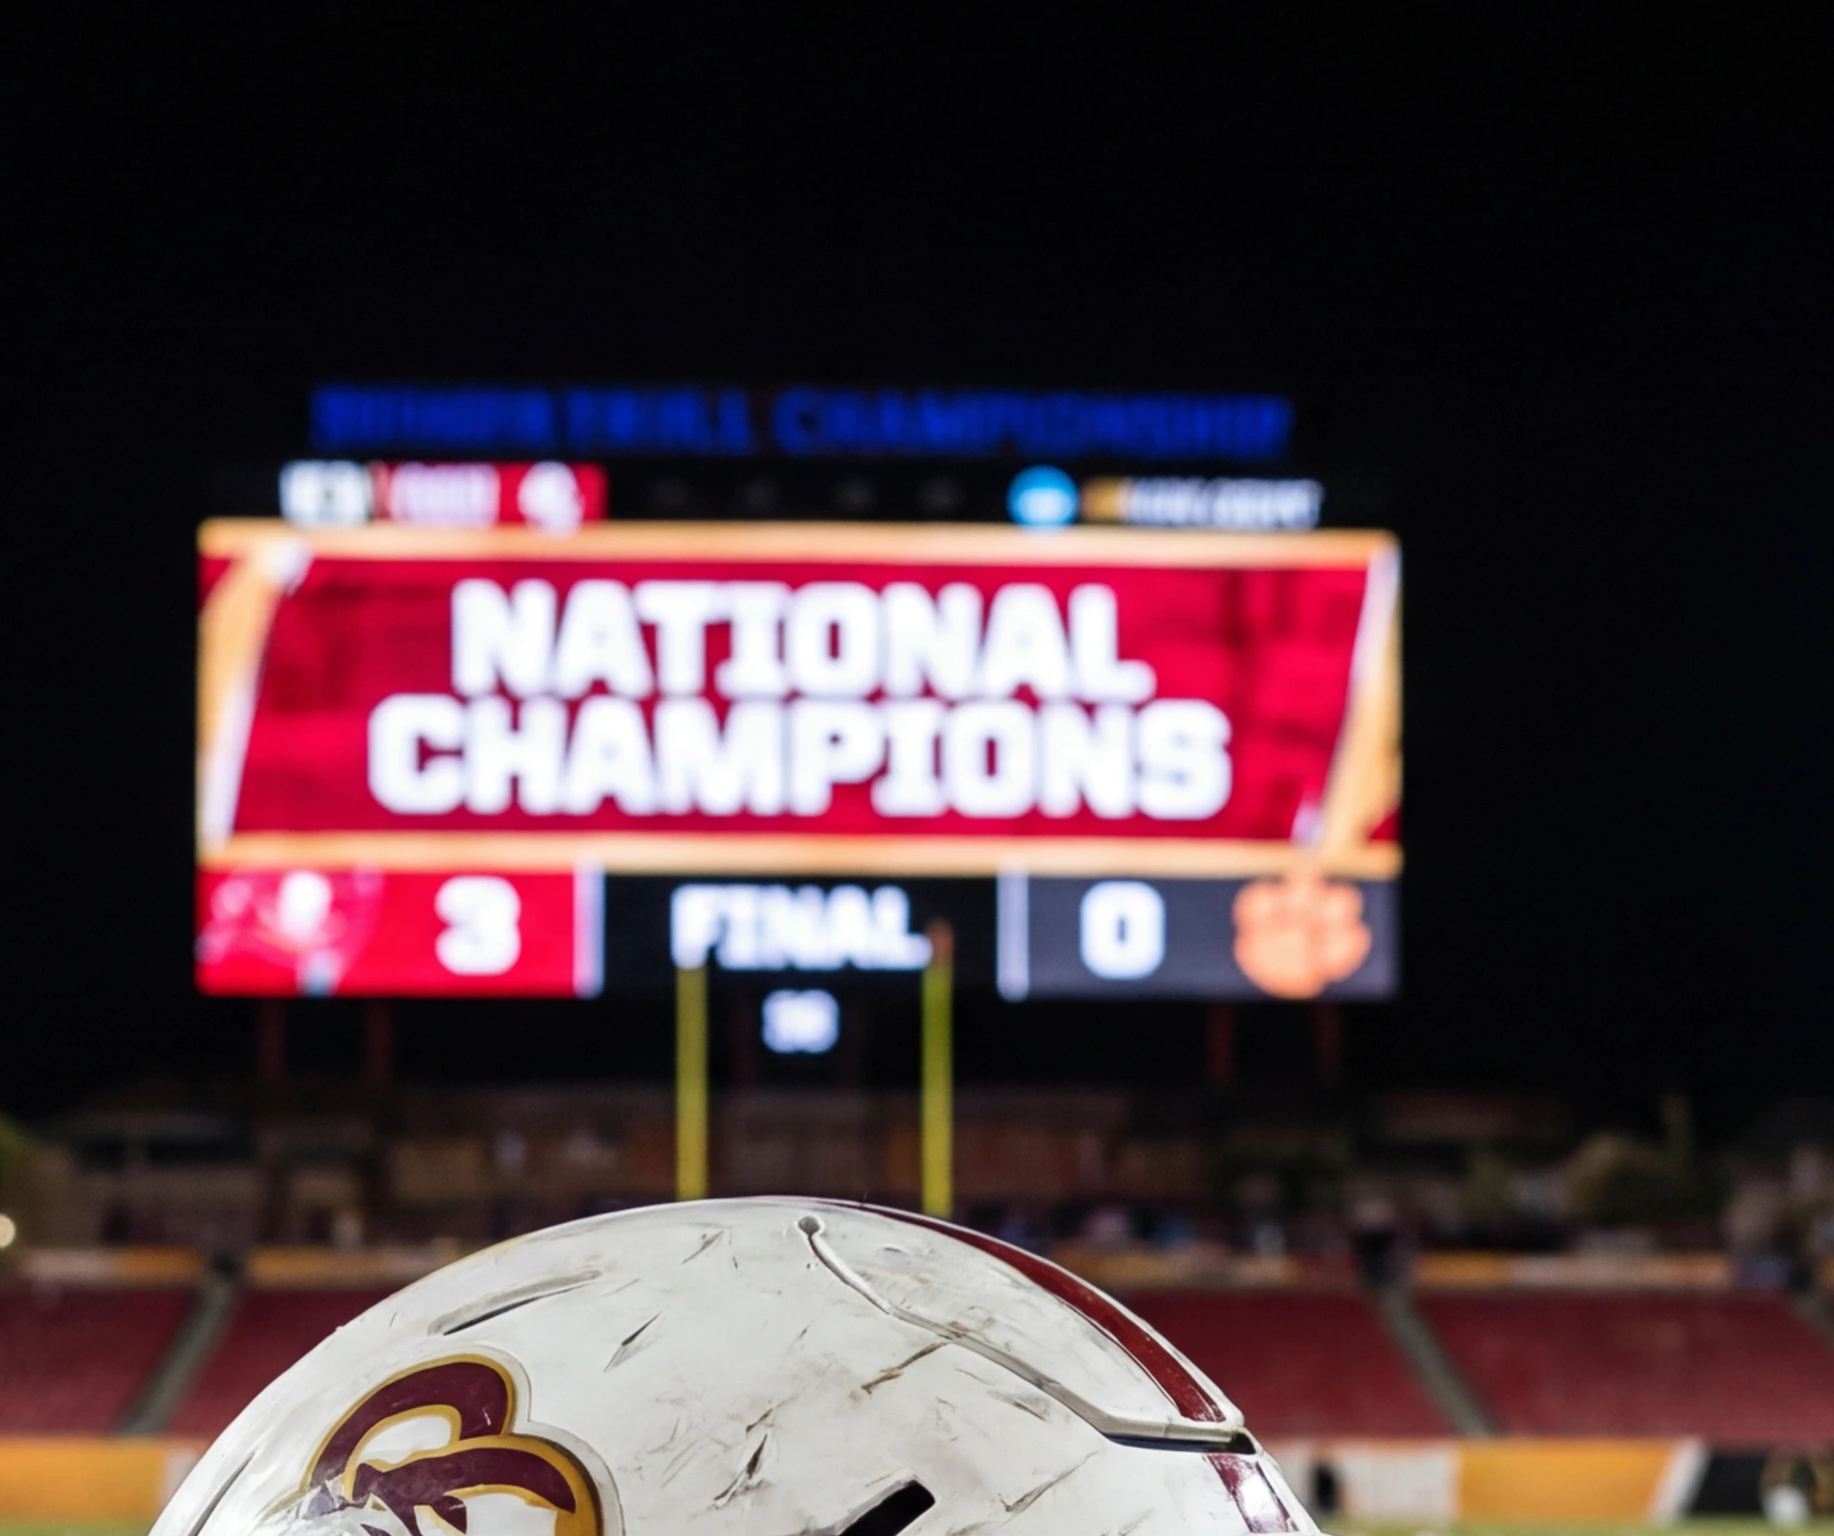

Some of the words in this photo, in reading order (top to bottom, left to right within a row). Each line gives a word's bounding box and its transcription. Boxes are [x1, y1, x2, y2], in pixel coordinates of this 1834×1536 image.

[450, 579, 1156, 702] NATIONAL
[368, 697, 1232, 821] CHAMPIONS
[435, 875, 521, 976] 3
[670, 885, 933, 970] FINAL
[1079, 880, 1167, 980] 0
